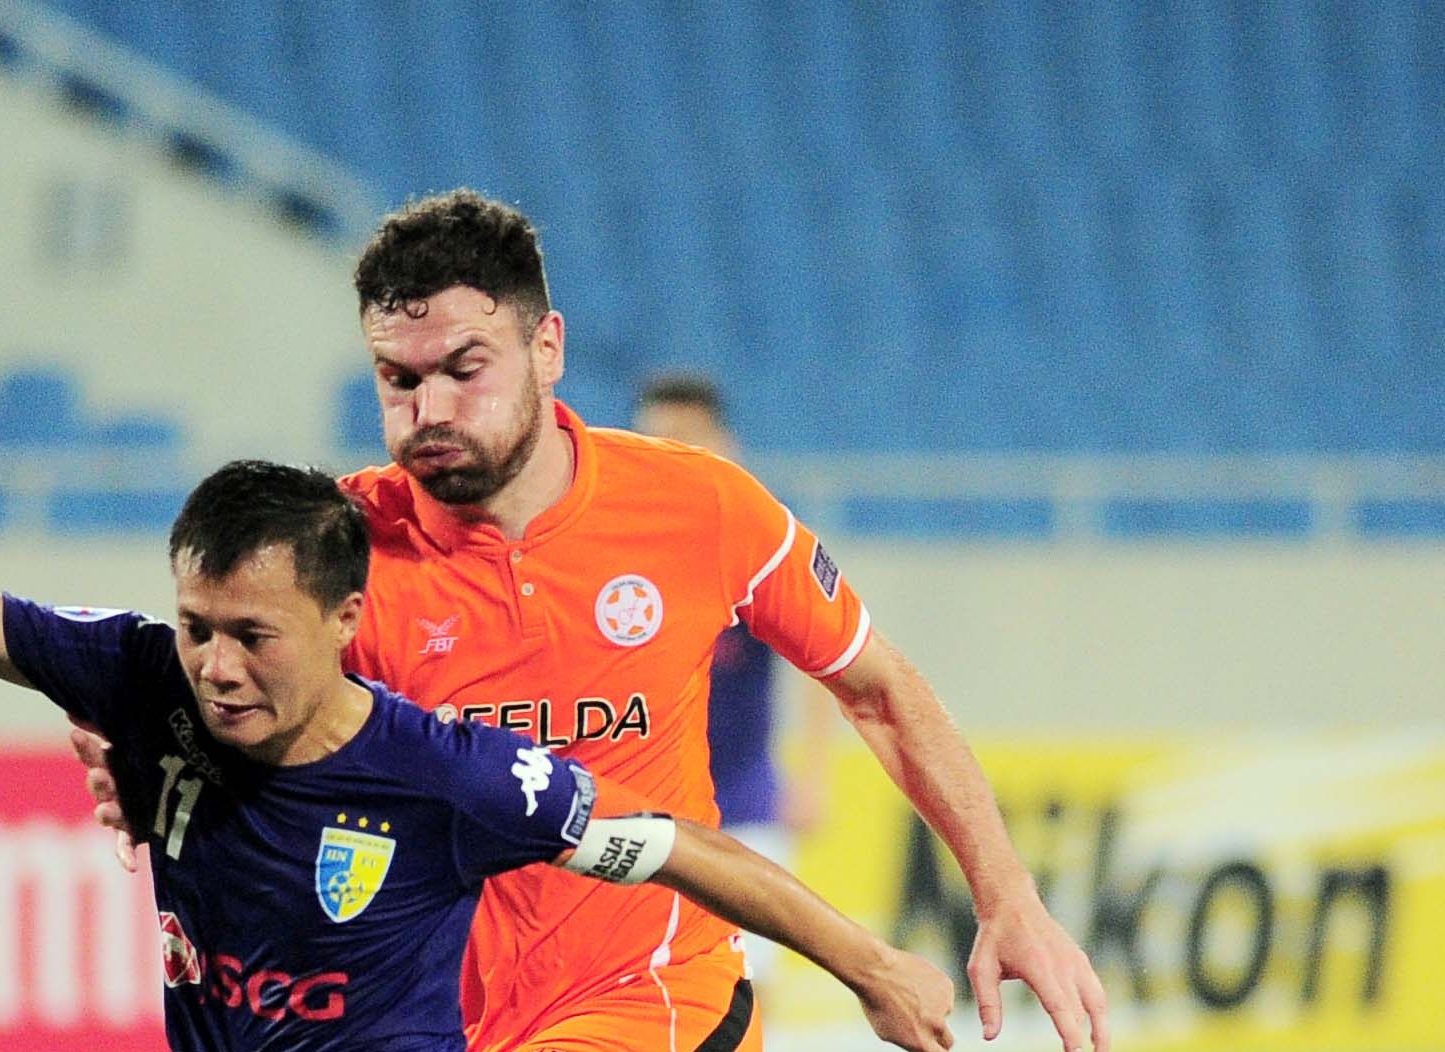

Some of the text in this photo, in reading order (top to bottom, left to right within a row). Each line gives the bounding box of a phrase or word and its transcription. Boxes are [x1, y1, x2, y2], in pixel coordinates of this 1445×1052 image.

[418, 636, 459, 654] FBT
[154, 754, 203, 861] 11
[592, 836, 627, 875] ASIA
[199, 954, 349, 1021] SCG
